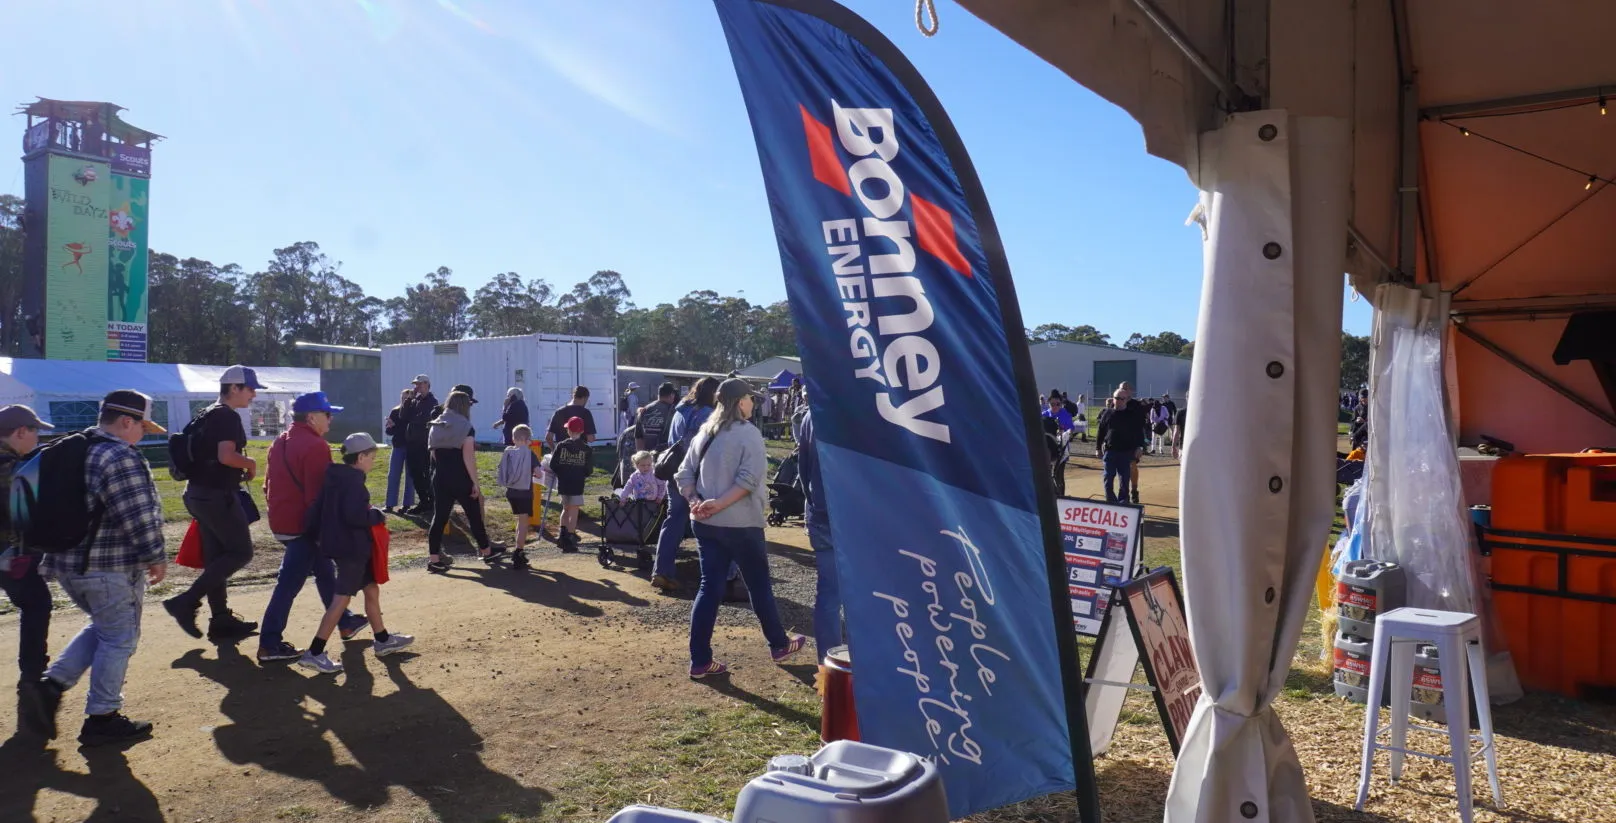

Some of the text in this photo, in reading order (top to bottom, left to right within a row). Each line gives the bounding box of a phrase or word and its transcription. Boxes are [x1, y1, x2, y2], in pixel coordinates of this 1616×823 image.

[119, 153, 149, 164] Scouts
[51, 188, 92, 207] WILD
[108, 237, 137, 249] Scouts
[831, 98, 952, 444] Bonney
[821, 217, 887, 386] ENERGY
[116, 323, 144, 332] TODAY
[1064, 507, 1128, 528] SPECIALS
[1064, 534, 1074, 542] 20L
[1070, 587, 1091, 596] ydraulic
[940, 524, 1010, 697] People
[898, 548, 983, 766] powering
[1153, 635, 1195, 691] CLAW
